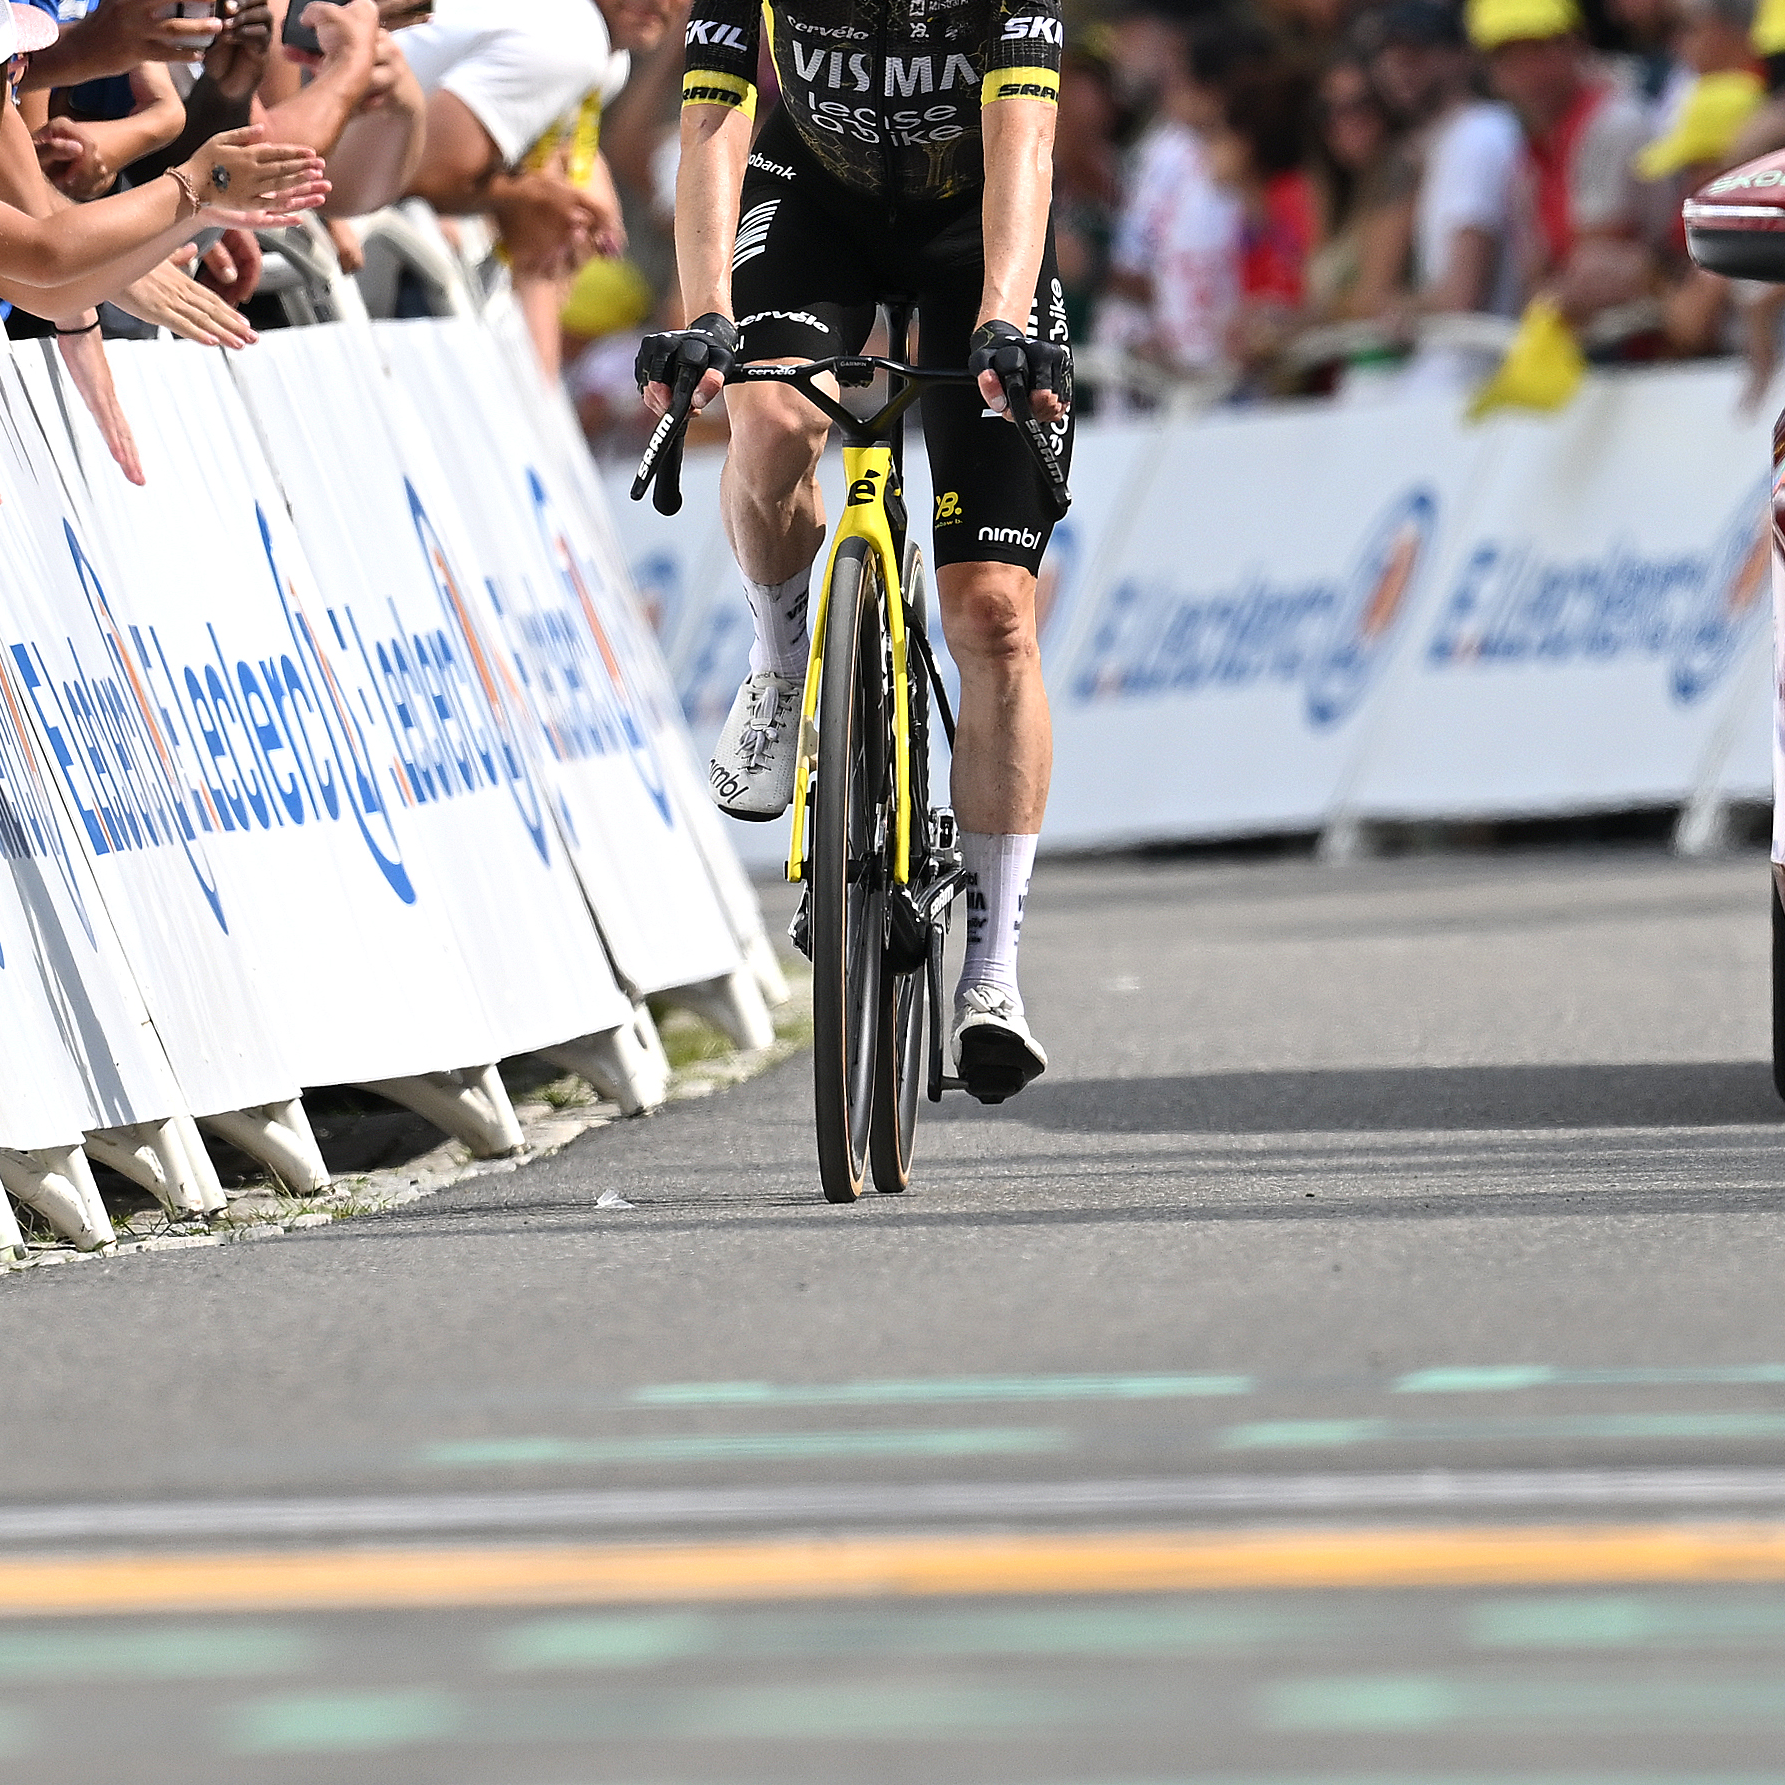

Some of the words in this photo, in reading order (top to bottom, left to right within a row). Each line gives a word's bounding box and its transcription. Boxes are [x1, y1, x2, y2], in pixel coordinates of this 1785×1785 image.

[792, 39, 981, 97] VISMA
[998, 83, 1058, 102] SRA
[748, 152, 797, 181] obank
[637, 412, 675, 481] SRAM
[978, 526, 1042, 550] nimbl
